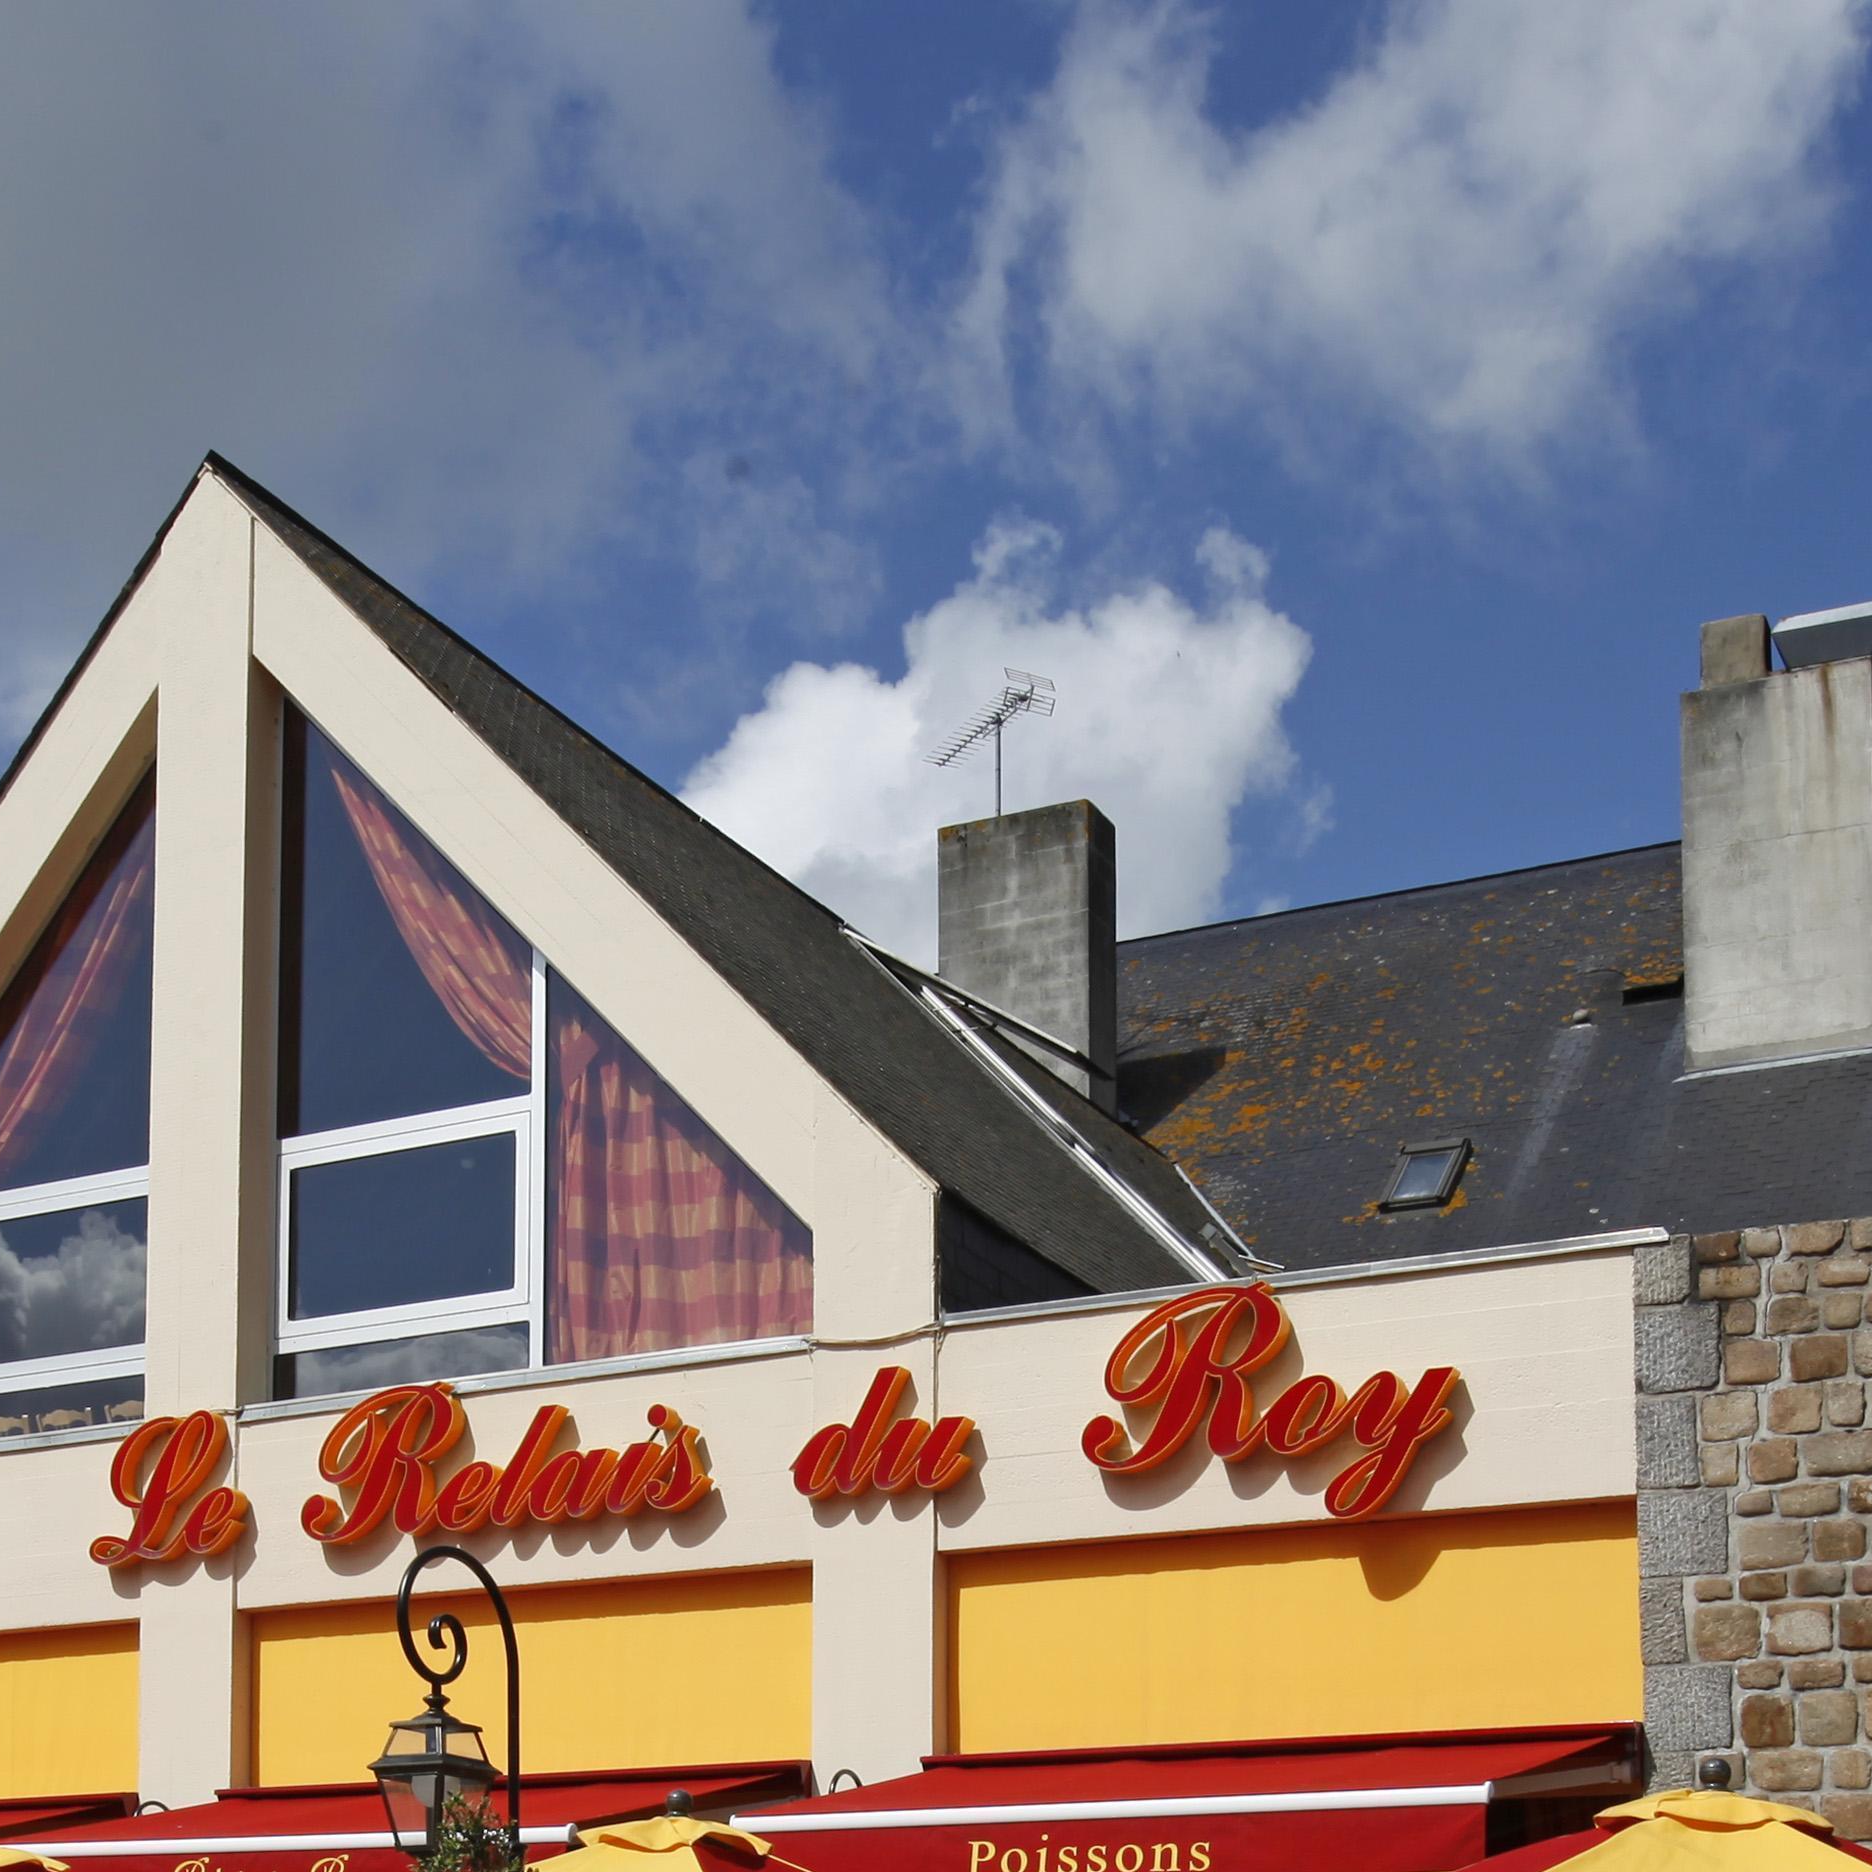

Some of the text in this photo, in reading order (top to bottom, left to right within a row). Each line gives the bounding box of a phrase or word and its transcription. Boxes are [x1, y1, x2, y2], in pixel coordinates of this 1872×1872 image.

[89, 1281, 1461, 1566] Le Relais du Roy
